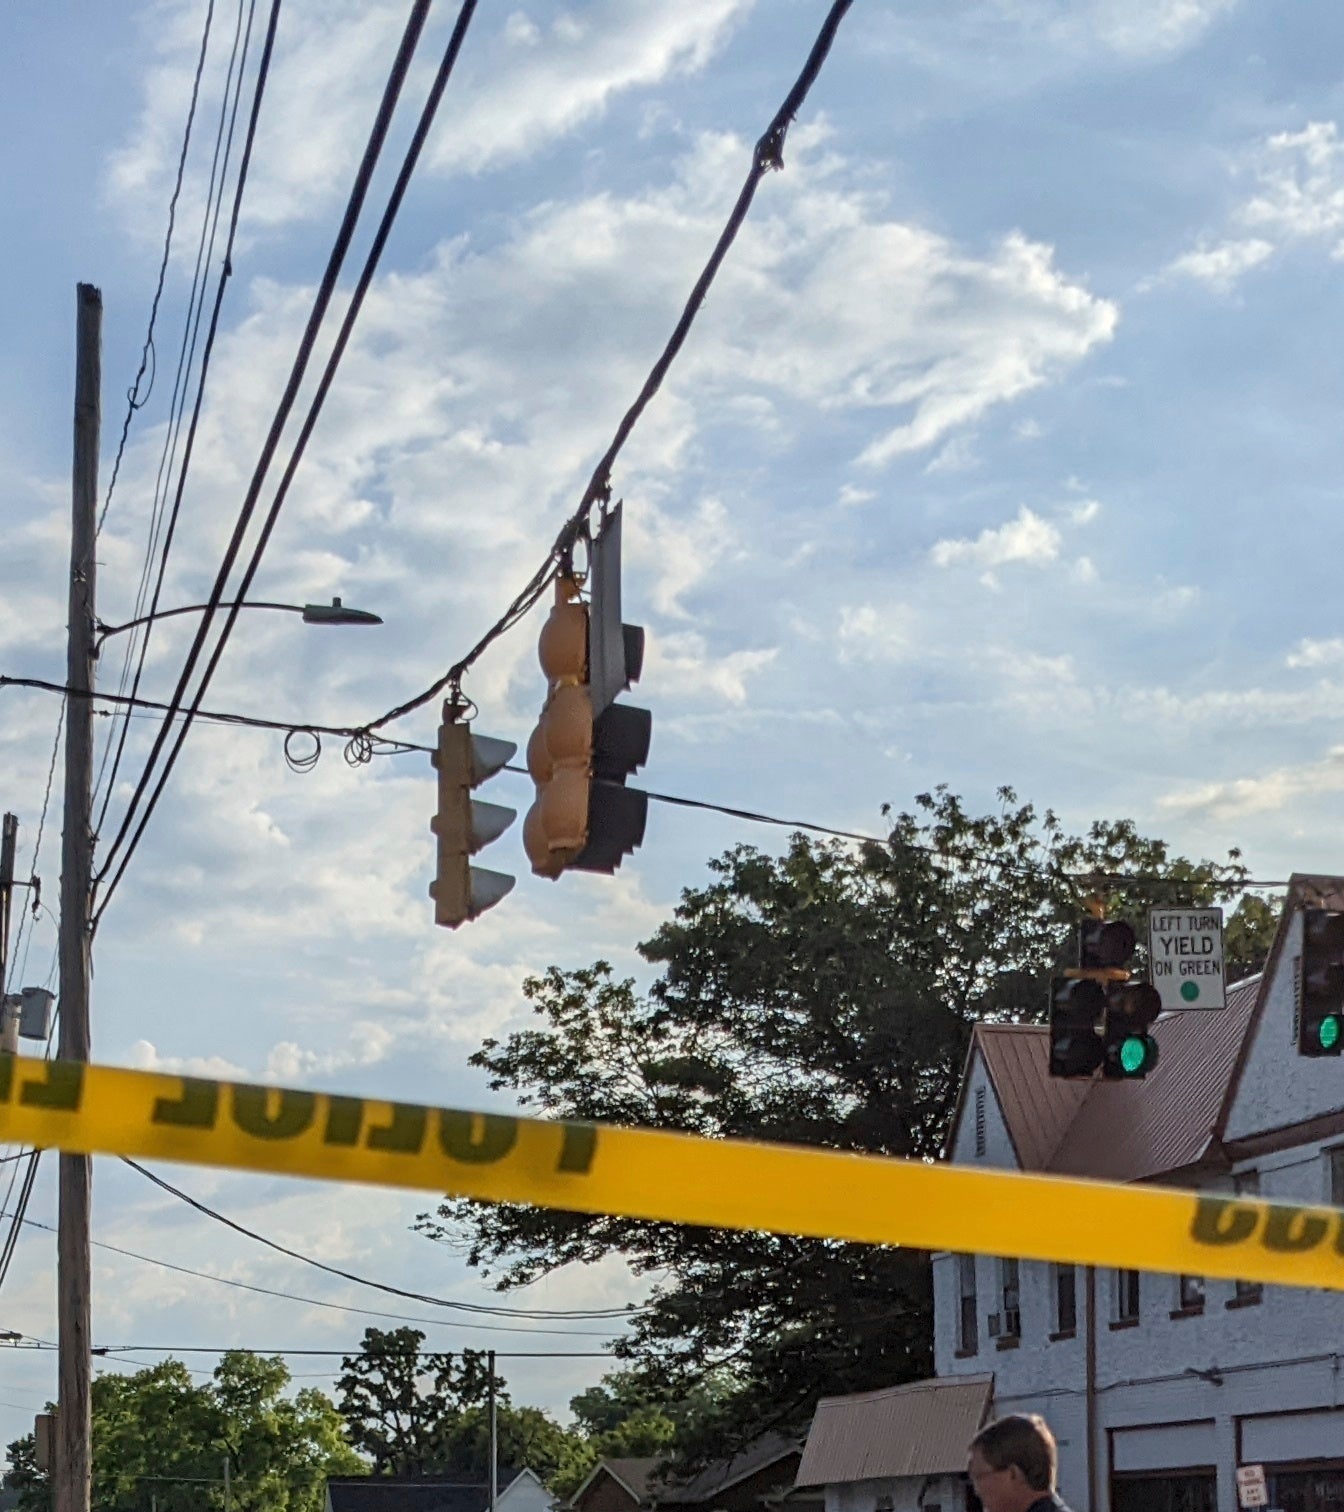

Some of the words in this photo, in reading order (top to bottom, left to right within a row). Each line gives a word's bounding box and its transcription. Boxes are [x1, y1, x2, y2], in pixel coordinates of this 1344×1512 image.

[1152, 916, 1181, 933] LEFT
[1188, 915, 1220, 932] TURN
[1160, 936, 1214, 956] YIELD
[1155, 961, 1173, 977] ON
[1179, 960, 1221, 976] GREEN
